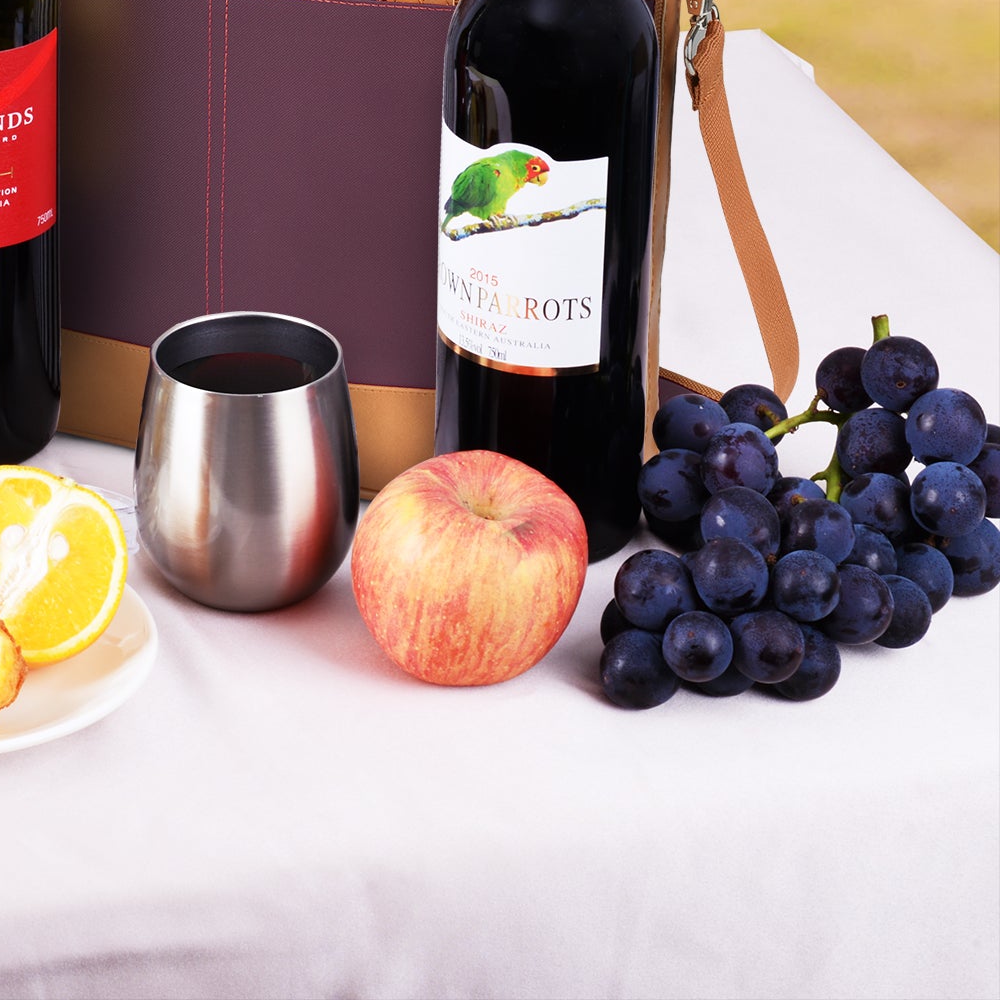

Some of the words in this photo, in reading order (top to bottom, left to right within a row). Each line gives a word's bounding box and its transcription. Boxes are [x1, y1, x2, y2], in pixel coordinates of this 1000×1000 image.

[469, 267, 499, 287] 2015
[477, 286, 592, 321] PARROTS
[460, 310, 508, 335] SHIRAZ
[494, 335, 551, 350] AUSTRALIA
